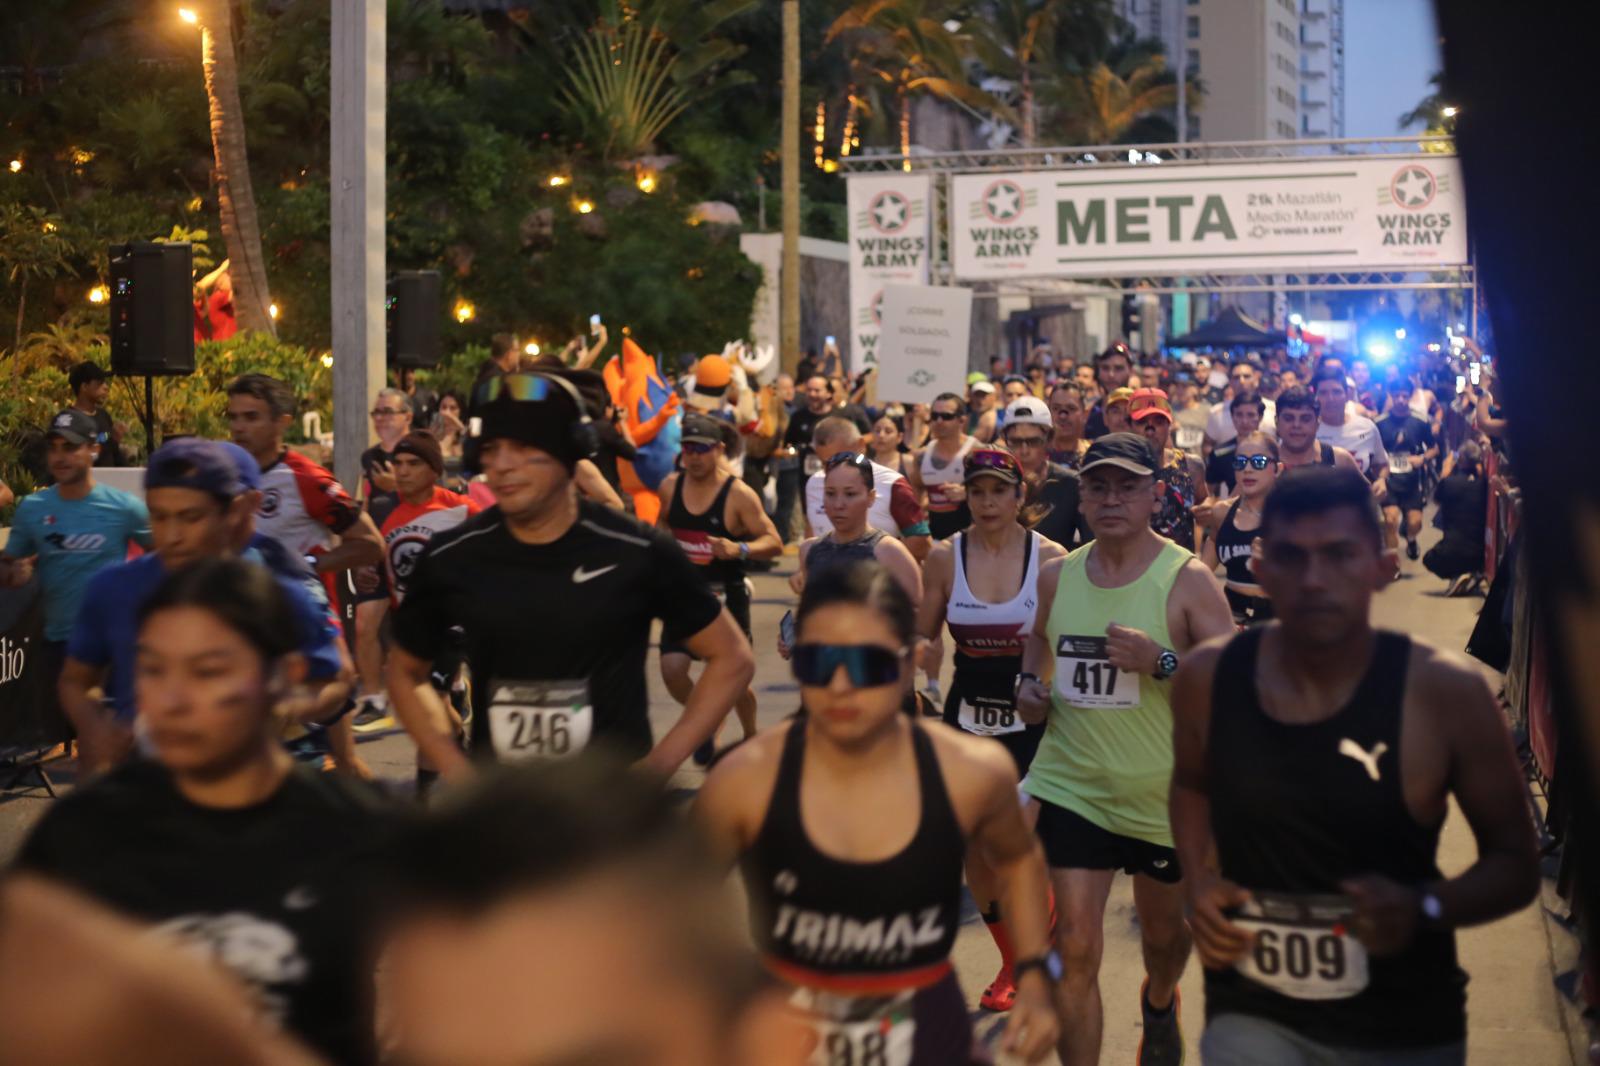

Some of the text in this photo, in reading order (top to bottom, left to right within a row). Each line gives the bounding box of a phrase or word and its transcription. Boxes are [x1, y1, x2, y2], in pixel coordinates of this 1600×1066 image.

[1277, 191, 1342, 205] Mazatlán
[1057, 194, 1238, 245] META
[975, 242, 1032, 258] ARMY
[1382, 230, 1444, 245] ARMY
[863, 254, 919, 268] ARMY
[1072, 661, 1118, 696] 417
[508, 711, 570, 755] 246
[774, 905, 945, 951] TRIMAZ
[1254, 929, 1346, 981] 609
